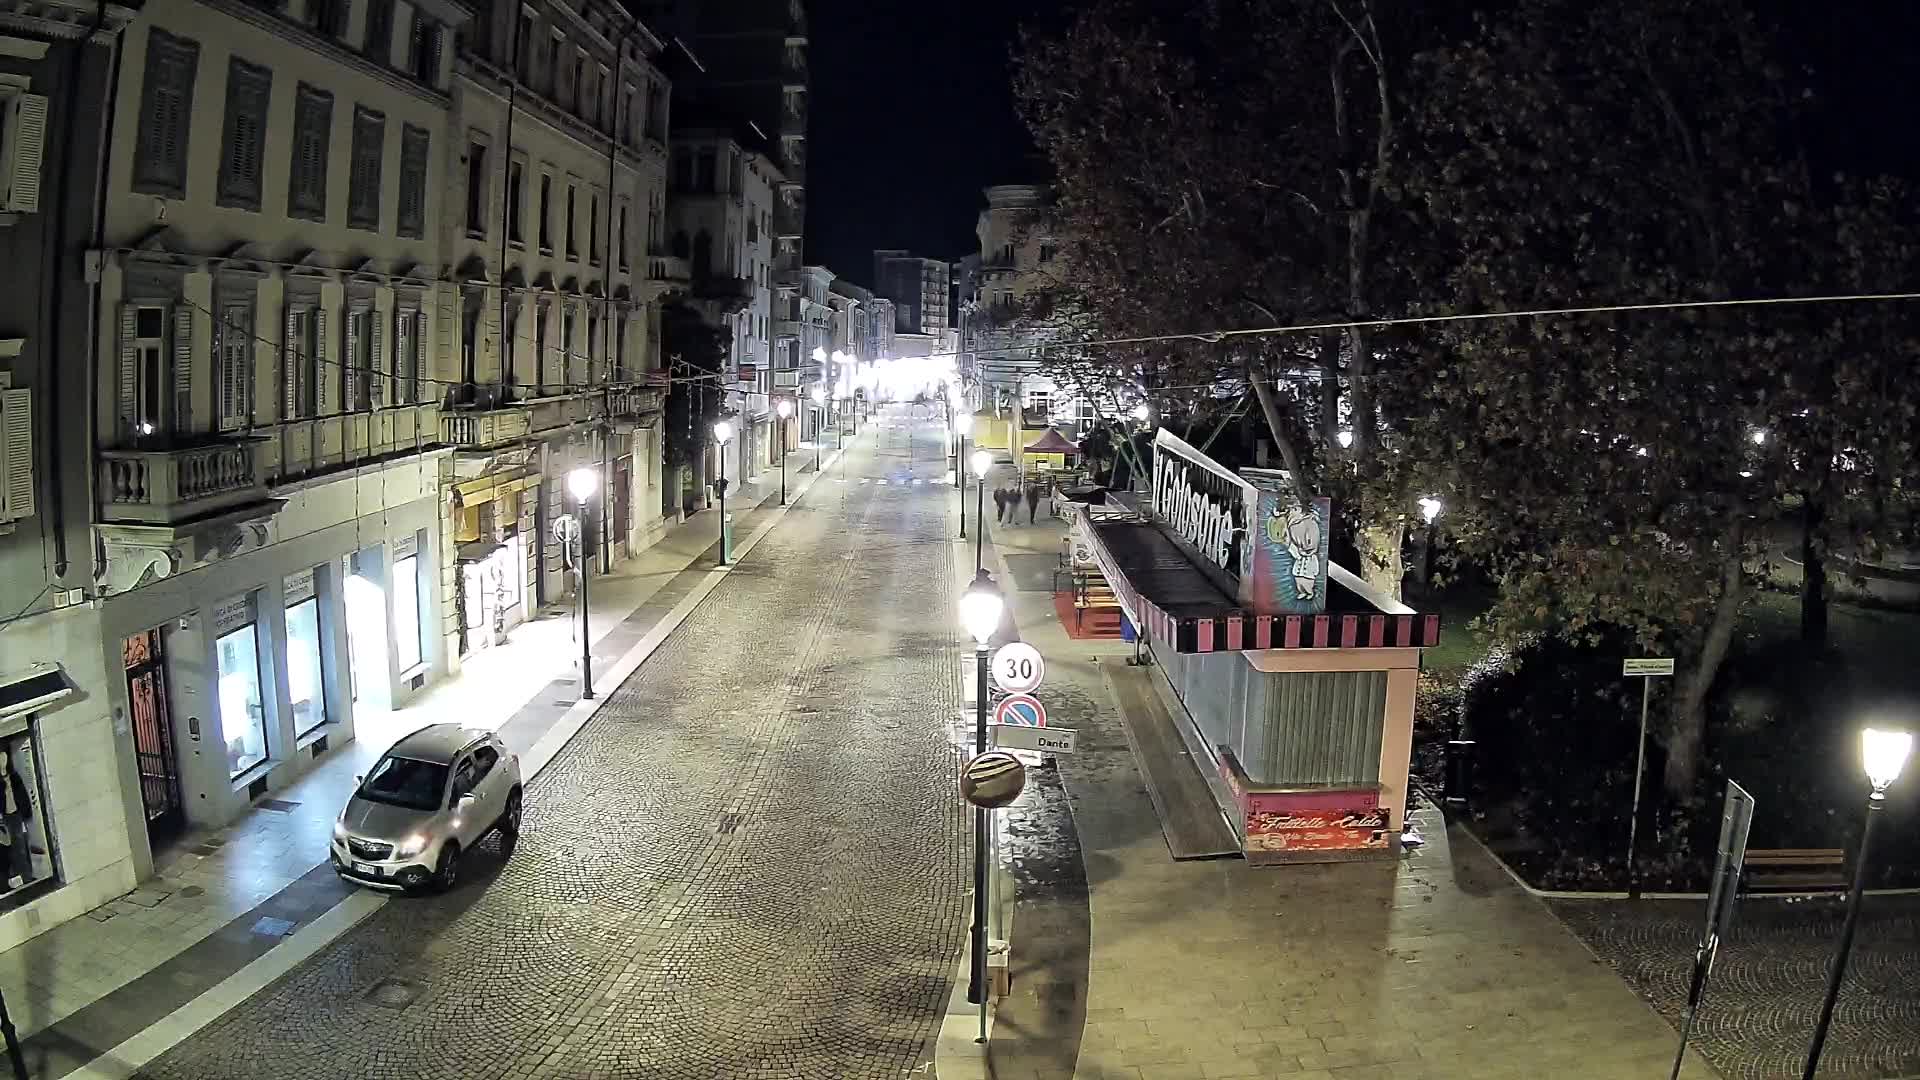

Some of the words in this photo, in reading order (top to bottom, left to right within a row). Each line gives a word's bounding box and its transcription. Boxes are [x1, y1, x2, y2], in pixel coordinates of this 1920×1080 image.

[1162, 458, 1233, 570] Golosone
[1006, 658, 1032, 679] 30
[1038, 737, 1069, 749] Dante
